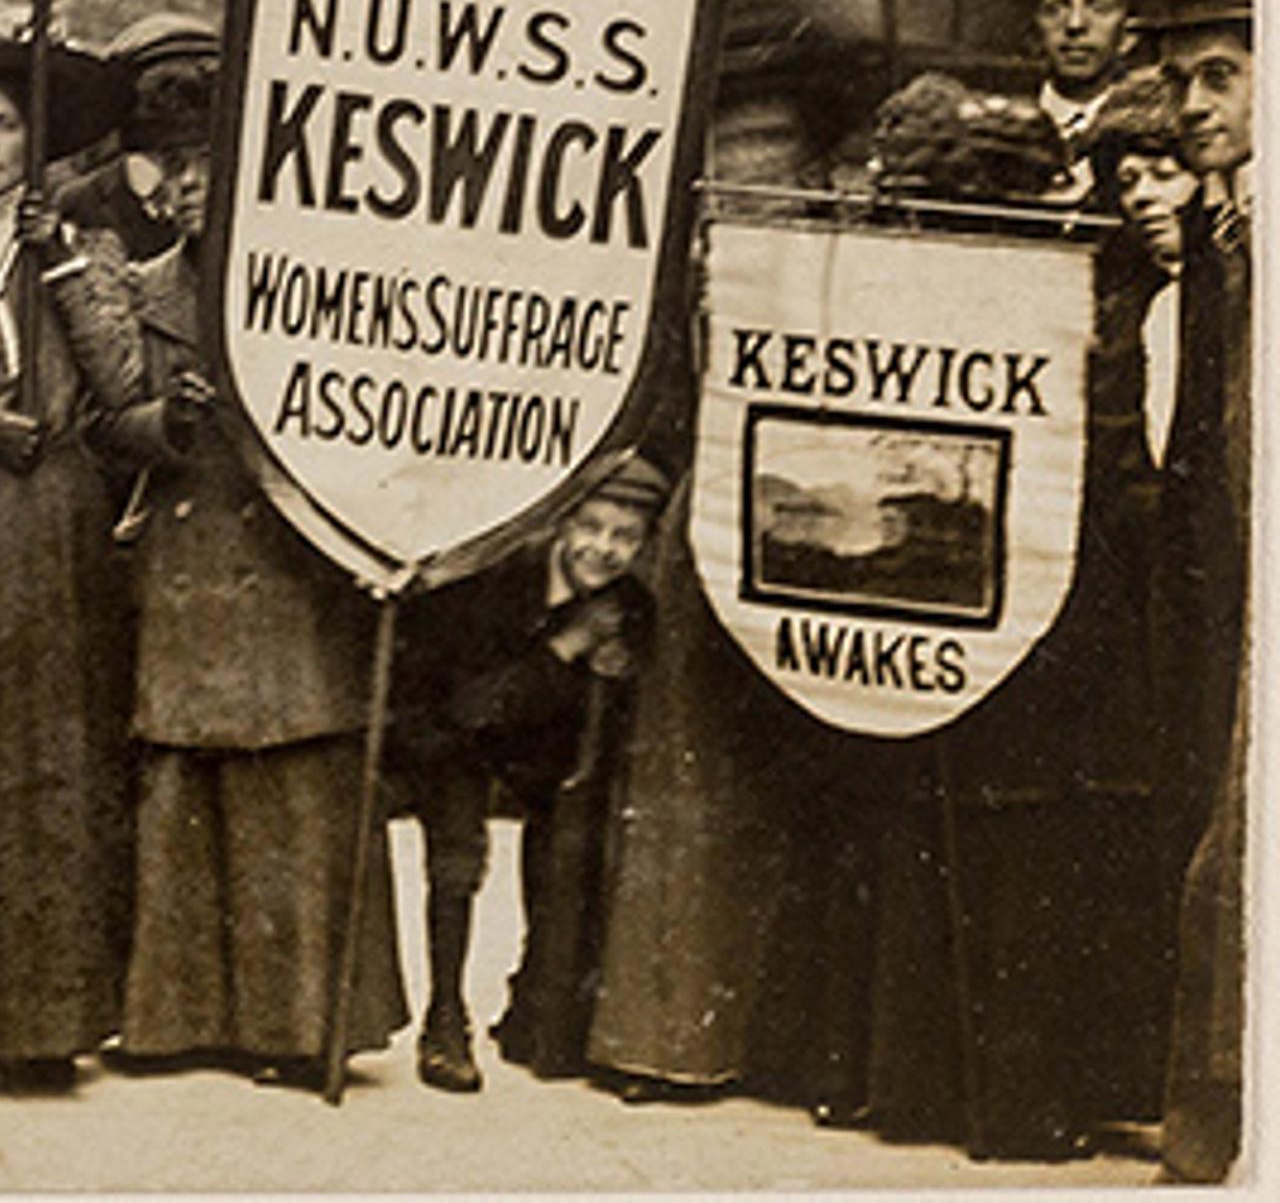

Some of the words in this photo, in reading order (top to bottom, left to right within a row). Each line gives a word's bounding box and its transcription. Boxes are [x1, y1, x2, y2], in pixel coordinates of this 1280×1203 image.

[257, 79, 662, 250] KESWICK
[273, 360, 581, 467] ASSOCIATION
[729, 328, 1050, 417] KESWICK
[776, 617, 967, 695] AWAKES
